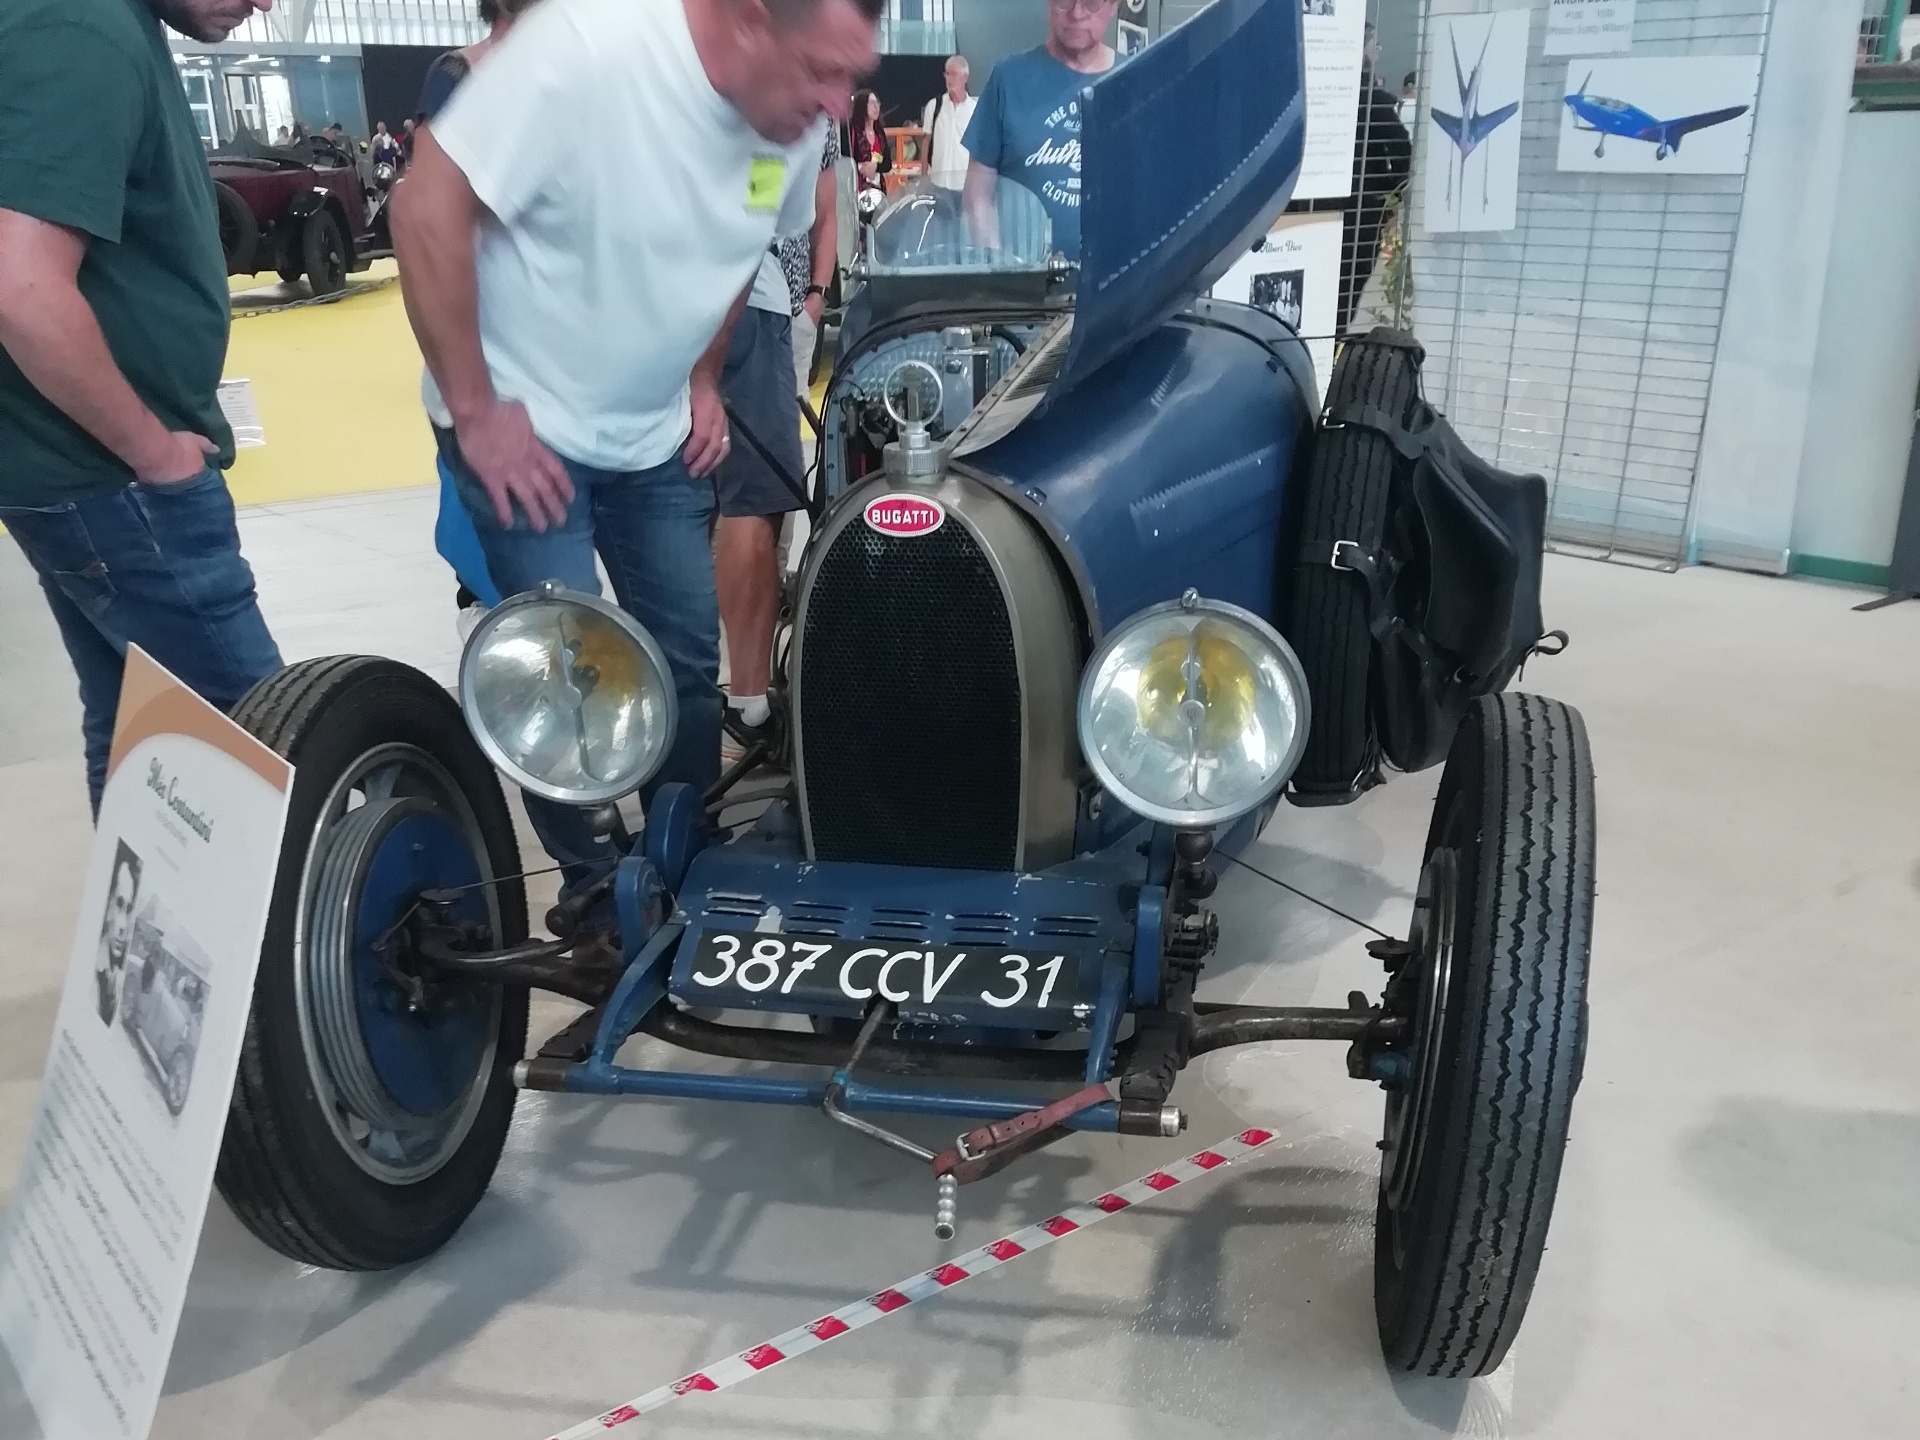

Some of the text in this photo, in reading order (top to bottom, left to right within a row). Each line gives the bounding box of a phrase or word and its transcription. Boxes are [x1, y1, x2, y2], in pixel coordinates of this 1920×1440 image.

[1044, 106, 1067, 129] THE
[1025, 137, 1081, 167] Auth
[1042, 180, 1081, 208] CLOTHI
[1260, 241, 1284, 254] Albert
[872, 509, 934, 525] BUGATTI
[692, 934, 1065, 1008] 387 CCV 31
